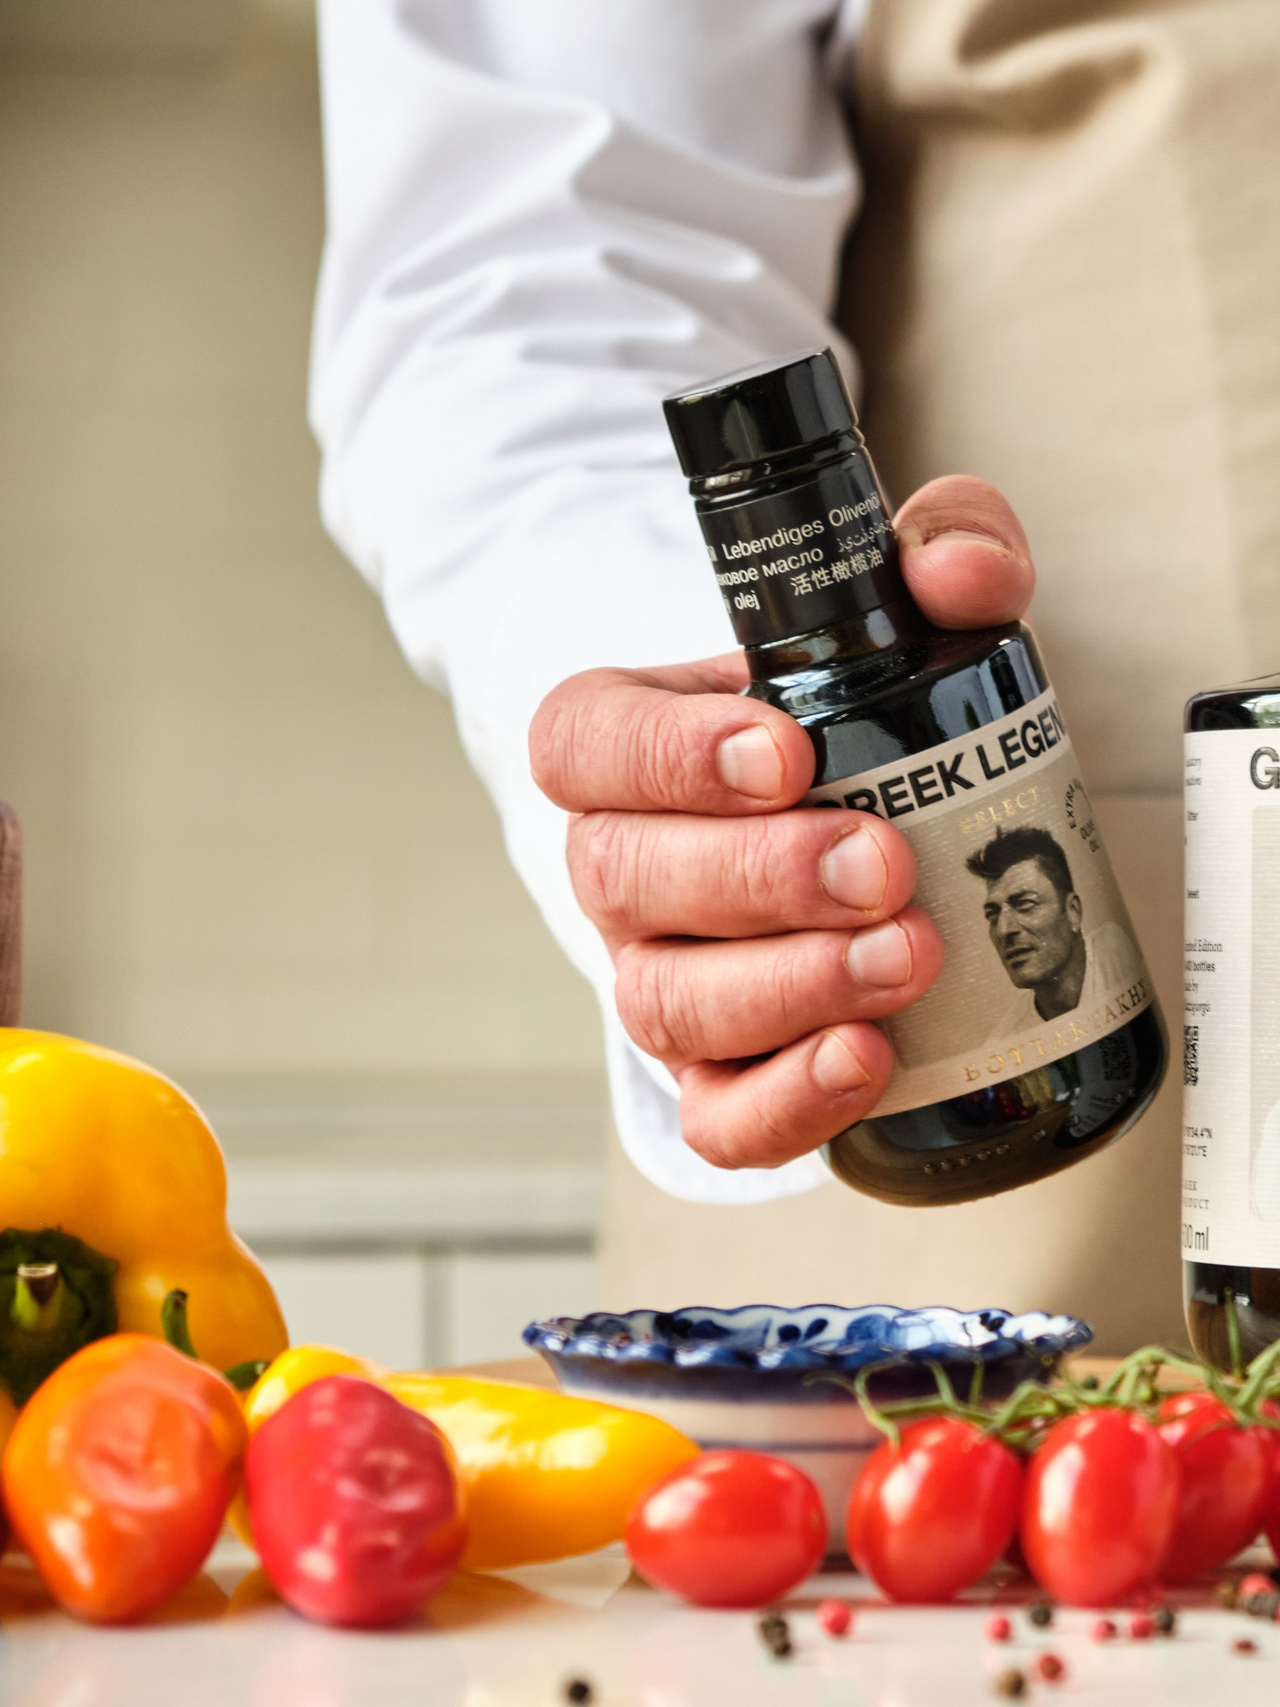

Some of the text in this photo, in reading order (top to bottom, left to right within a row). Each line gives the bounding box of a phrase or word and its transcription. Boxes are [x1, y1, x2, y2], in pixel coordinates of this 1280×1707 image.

[722, 519, 825, 561] Lebendiges
[761, 547, 824, 577] масло
[790, 547, 885, 597] 活性橄榄油
[734, 590, 761, 610] olej
[975, 700, 1066, 782] LEGEN
[1193, 960, 1216, 972] bottles
[1194, 1226, 1209, 1250] ml
